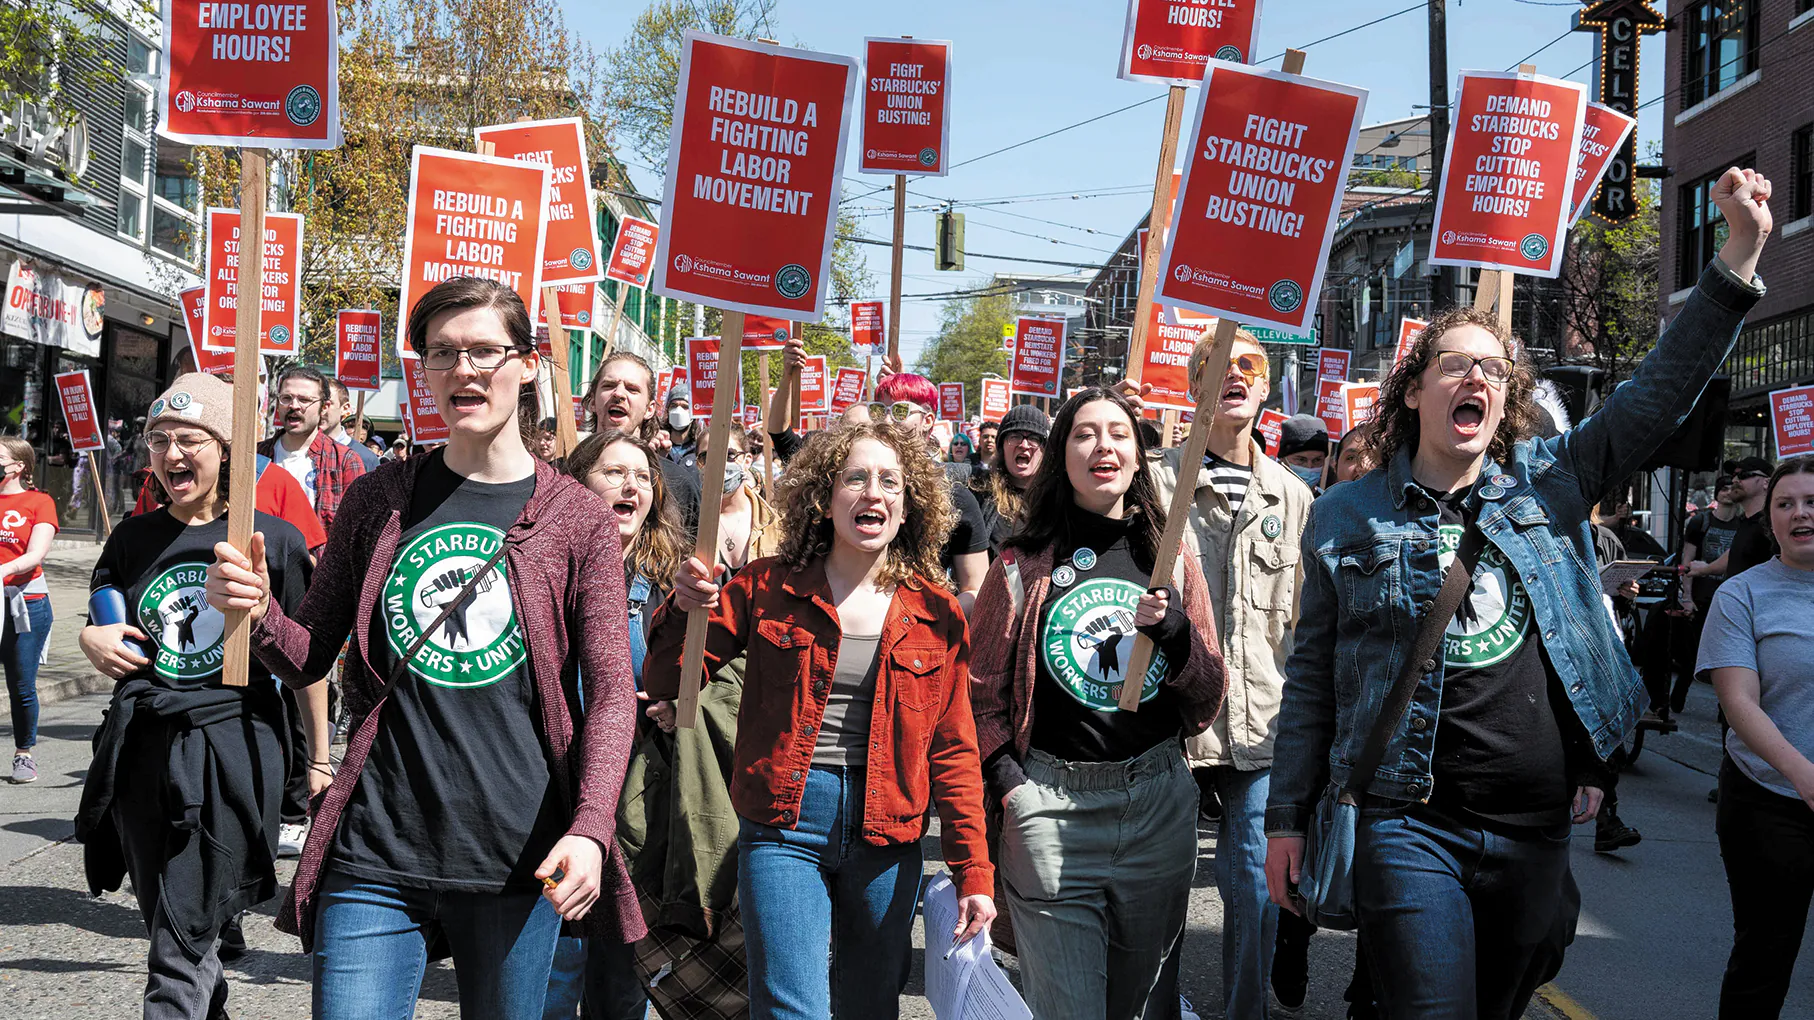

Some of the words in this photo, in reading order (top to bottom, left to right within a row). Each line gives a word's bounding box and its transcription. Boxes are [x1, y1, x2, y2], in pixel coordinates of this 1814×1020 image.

[199, 3, 306, 30] EMPLOYEE
[1168, 5, 1223, 29] HOURS!
[212, 34, 290, 62] HOURS!
[1152, 50, 1183, 59] Kshama
[1184, 52, 1211, 60] Sawant
[890, 63, 924, 78] FIGHT
[870, 78, 941, 95] STARBUCKS'
[197, 97, 239, 108] Kshama
[241, 98, 280, 110] Sawant
[708, 85, 798, 124] REBUILD
[802, 102, 817, 128] A
[887, 95, 923, 110] UNION
[1486, 95, 1551, 118] DEMAND
[877, 110, 931, 125] BUSTING!
[1607, 17, 1632, 212] CELOR
[1243, 113, 1308, 150] FIGHT
[1471, 114, 1560, 140] STARBUCKS
[710, 116, 808, 157] FIGHTING
[1491, 136, 1532, 157] STOP
[720, 149, 791, 184] LABOR
[1203, 135, 1335, 184] STARBUCKS'
[1475, 155, 1540, 178] CUTTING
[693, 173, 813, 216] MOVEMENT
[1228, 170, 1296, 207] UNION
[1465, 174, 1545, 200] EMPLOYEE
[434, 189, 507, 218] REBUILD
[511, 200, 524, 220] A
[1472, 195, 1530, 218] HOURS!
[1205, 195, 1305, 238] BUSTING!
[232, 226, 277, 241] DND
[436, 214, 517, 244] FIGHTING
[630, 225, 652, 237] DEMAND
[624, 230, 653, 245] STARBUCKS
[630, 239, 644, 248] STOP
[1456, 235, 1487, 244] Kshama
[1488, 238, 1517, 247] Sawant
[224, 241, 285, 256] STACKS
[445, 239, 504, 266] LABOR
[226, 255, 281, 270] REATE
[544, 258, 568, 267] Sawant
[217, 268, 237, 281] ALL
[693, 261, 732, 277] Kshama
[733, 269, 770, 283] Sawant
[1192, 272, 1229, 287] Kshama
[1230, 280, 1265, 295] Sawant
[345, 324, 373, 334] REBUILD
[372, 325, 377, 334] A
[1028, 326, 1053, 335] DEMAND
[1158, 325, 1201, 342] FIGHTING
[1248, 329, 1294, 340] ELLEVUE
[347, 334, 375, 343] FIGHTING
[1023, 334, 1056, 343] STARBUCKS
[351, 343, 373, 352] LABOR
[1024, 342, 1054, 351] REINSTATE
[1163, 339, 1194, 355] LABOR
[343, 352, 377, 362] MOVEMENT
[696, 352, 719, 361] REBUI
[1030, 350, 1057, 359] WORKERS
[1040, 358, 1052, 366] FOR
[1150, 351, 1189, 368] MOVEM
[698, 361, 718, 370] FIGHT
[703, 371, 717, 379] LAB
[696, 380, 716, 389] MOVE
[1779, 400, 1813, 412] STARBUCKS
[1782, 394, 1807, 404] DEMAND
[1784, 414, 1811, 424] CUTTING
[1789, 408, 1805, 417] STOP
[1783, 421, 1814, 431] EMPLOYEE
[1788, 429, 1811, 438] HOURS!
[409, 534, 497, 569] STARBU
[150, 570, 209, 601] STARBU
[1062, 587, 1140, 620] STARBUC
[1489, 582, 1526, 646] UNITED
[387, 593, 455, 673] WORERS
[475, 625, 521, 671] UNIT
[1049, 639, 1108, 700] WORKERS
